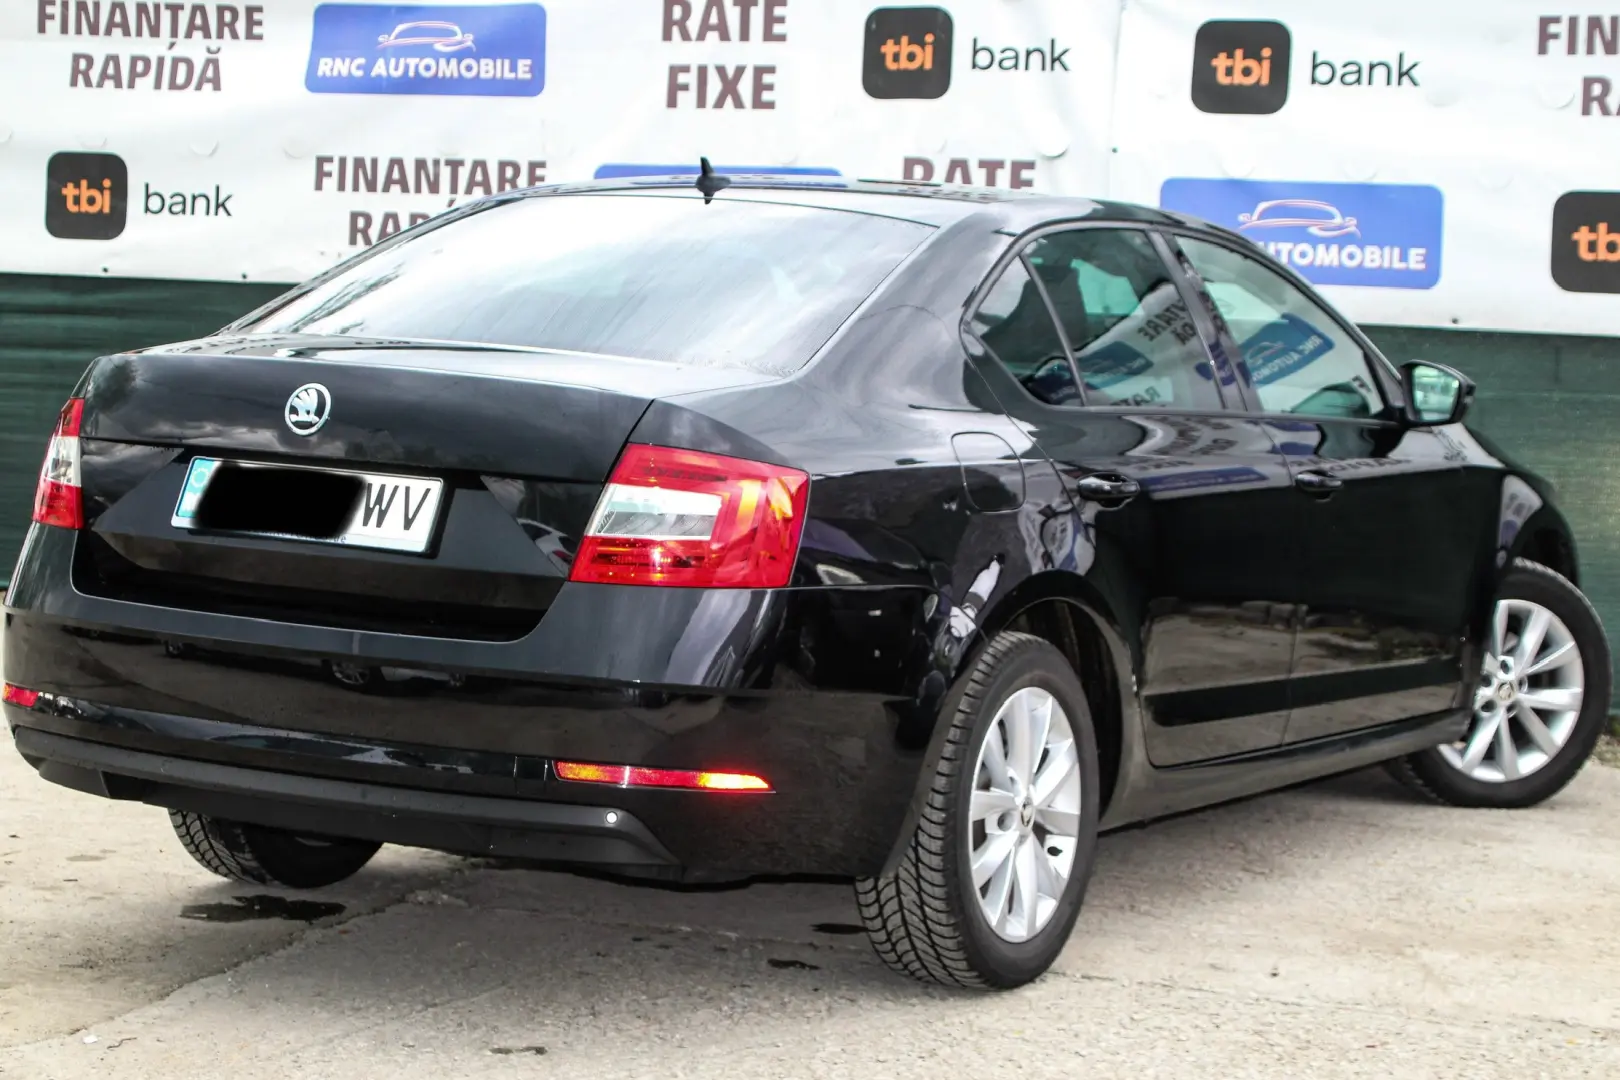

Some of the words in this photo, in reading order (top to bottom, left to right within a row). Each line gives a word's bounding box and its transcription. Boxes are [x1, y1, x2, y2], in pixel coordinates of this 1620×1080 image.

[662, 0, 788, 42] RATE
[316, 56, 365, 77] RNC
[370, 58, 532, 80] AUTOMOBILE
[880, 32, 935, 71] tbi
[971, 37, 1070, 72] bank
[1211, 47, 1272, 86] tbi
[1310, 51, 1420, 87] bank
[666, 64, 776, 109] FIXE
[62, 178, 111, 214] tbi
[143, 182, 233, 217] bank
